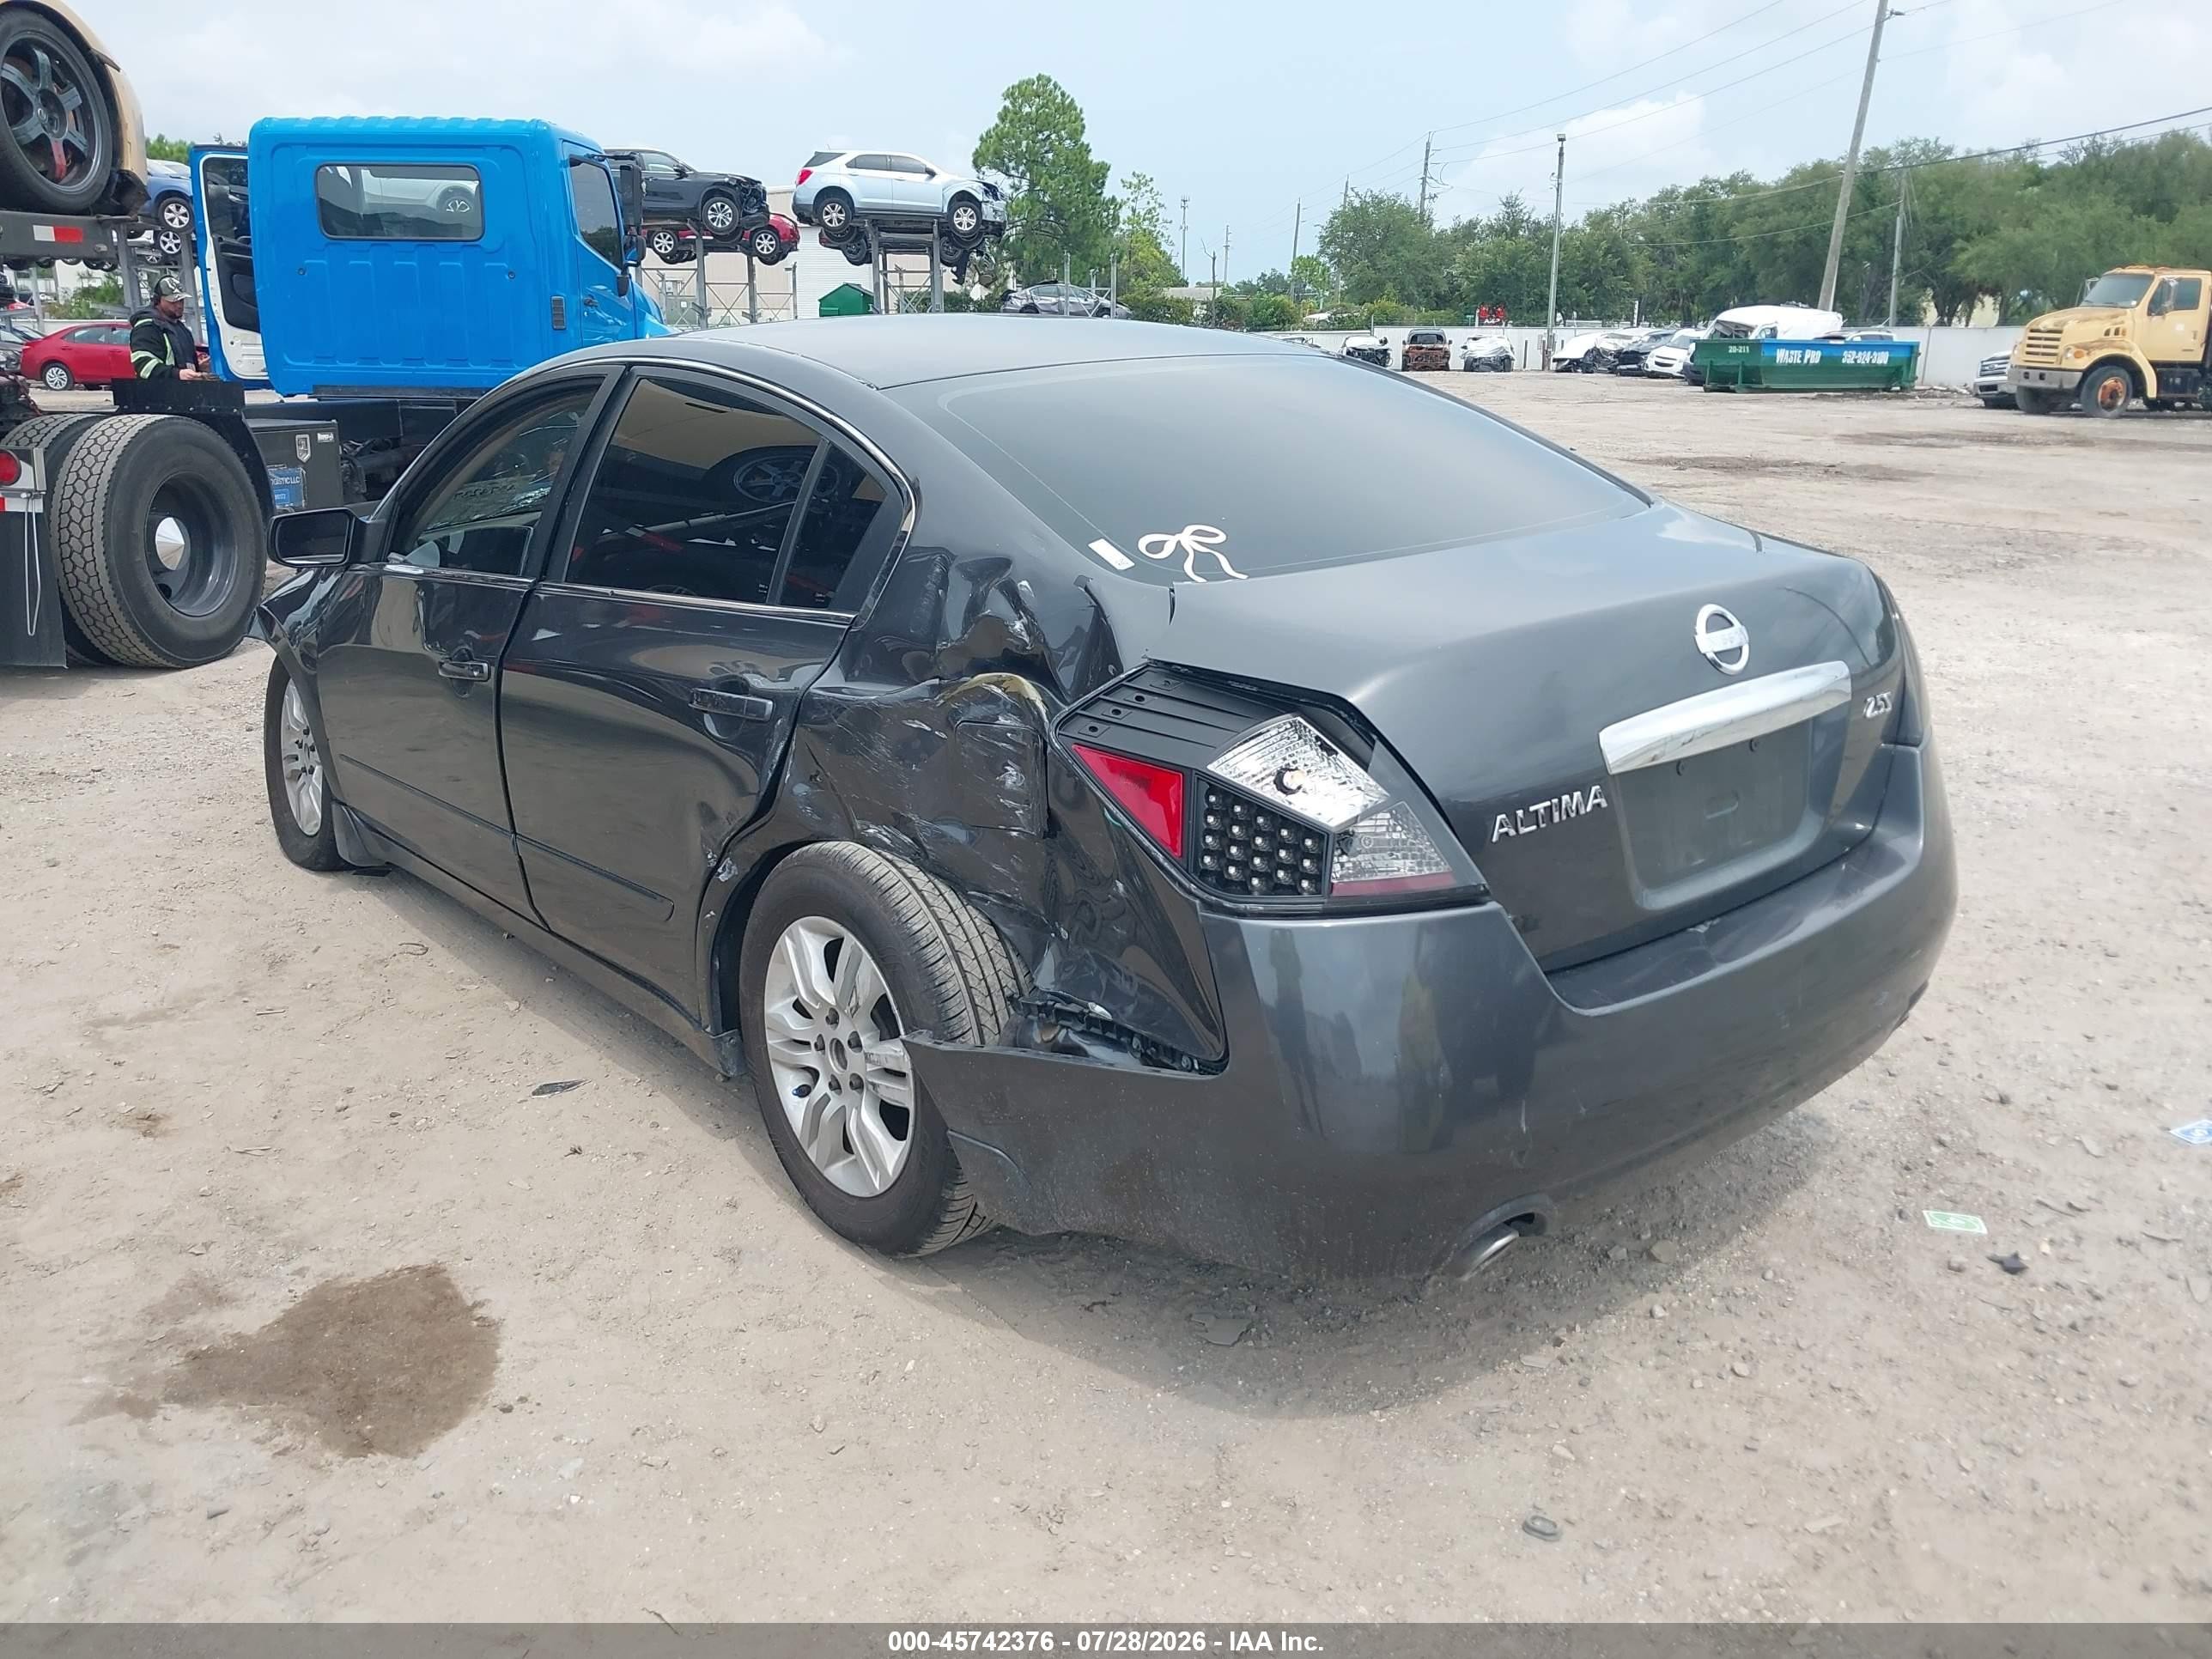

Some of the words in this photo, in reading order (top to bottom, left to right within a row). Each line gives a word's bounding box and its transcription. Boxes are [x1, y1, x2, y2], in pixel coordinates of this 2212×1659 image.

[1728, 345, 1749, 354] 20-211
[1776, 348, 1802, 364] WASTE
[1803, 349, 1822, 364] PRO
[1491, 785, 1608, 843] ALTIMA
